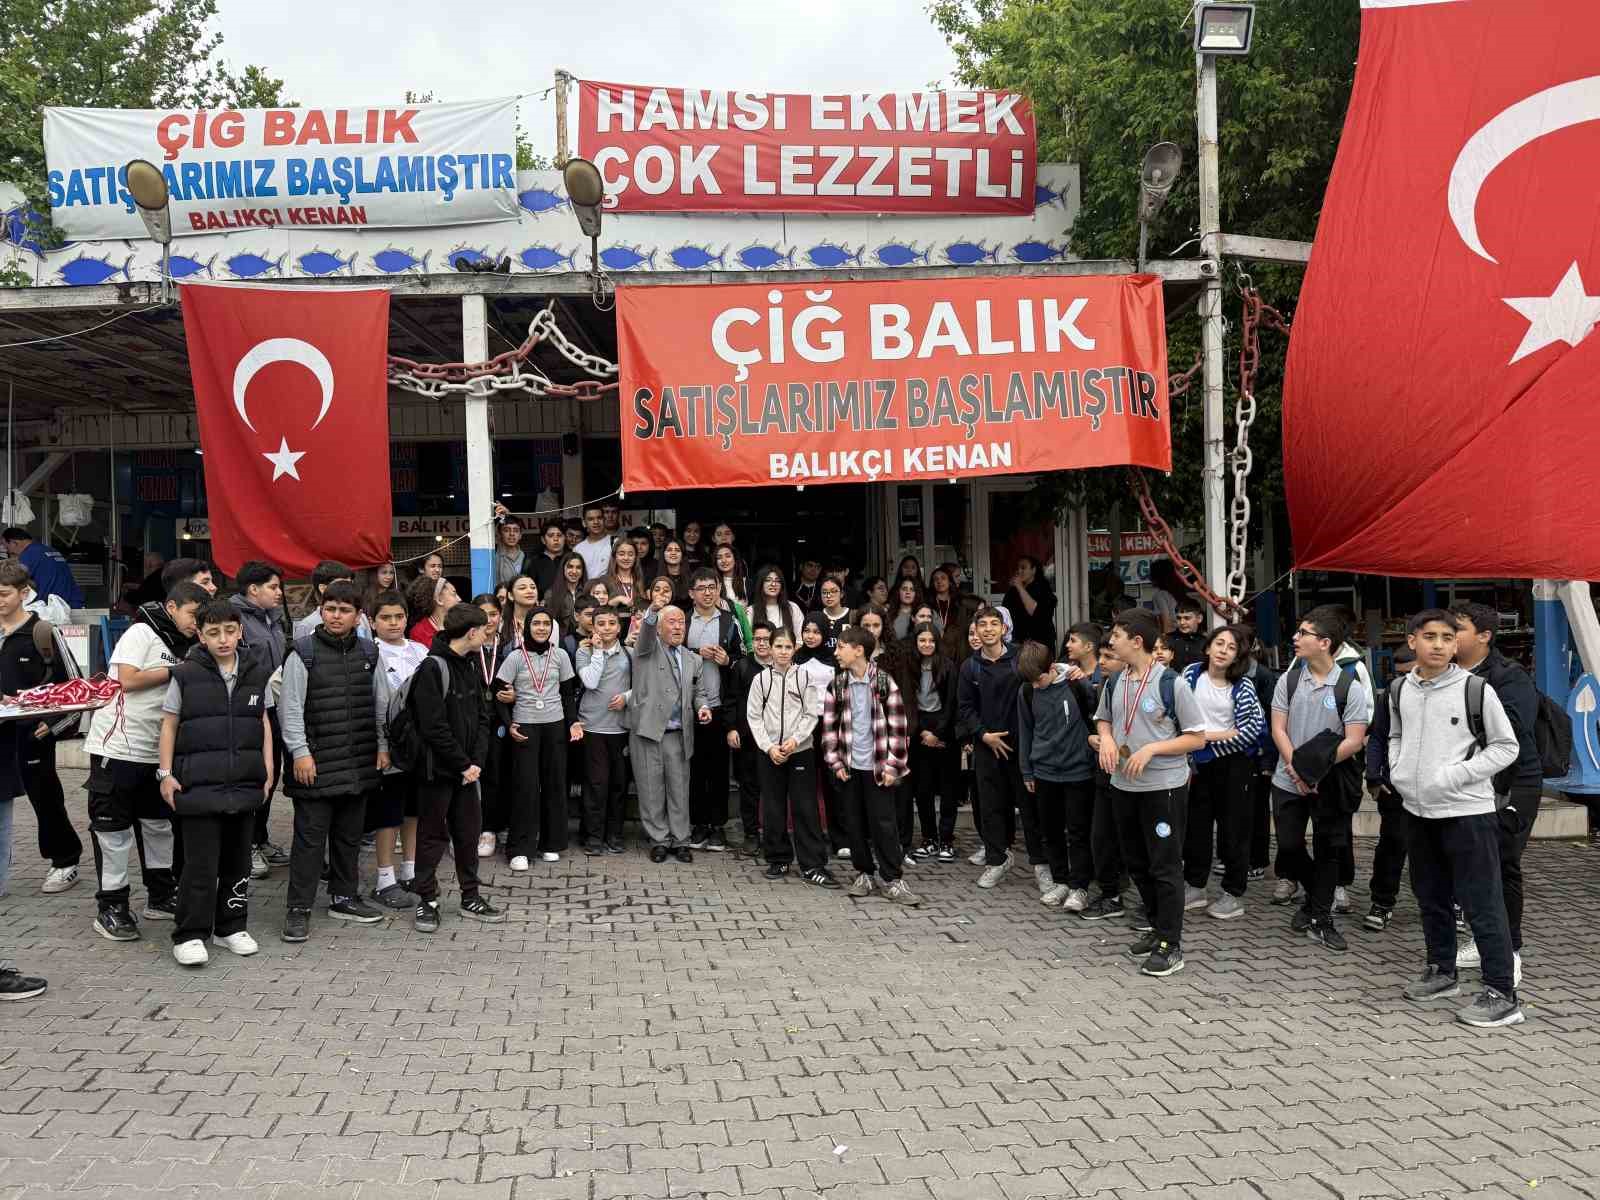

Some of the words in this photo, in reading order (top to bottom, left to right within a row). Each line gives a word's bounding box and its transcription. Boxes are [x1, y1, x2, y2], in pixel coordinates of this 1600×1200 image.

[264, 109, 420, 146] BALIK
[811, 90, 1025, 136] EKMEK
[48, 160, 278, 214] SATIŞARIMIZ
[286, 153, 515, 205] BAŞLAMIŞTIR
[593, 145, 723, 209] ÇOK
[189, 207, 282, 231] BALIKÇI
[288, 205, 368, 225] KENAN
[711, 289, 846, 383] ÇİĞ
[869, 298, 1096, 360] BALIK
[633, 379, 898, 450] SATIŞLARIMIZ
[905, 365, 1160, 440] BAŞLAMIŞTIR
[769, 449, 892, 481] BALIKÇI
[903, 441, 1012, 473] KENAN
[398, 519, 450, 533] BALIK
